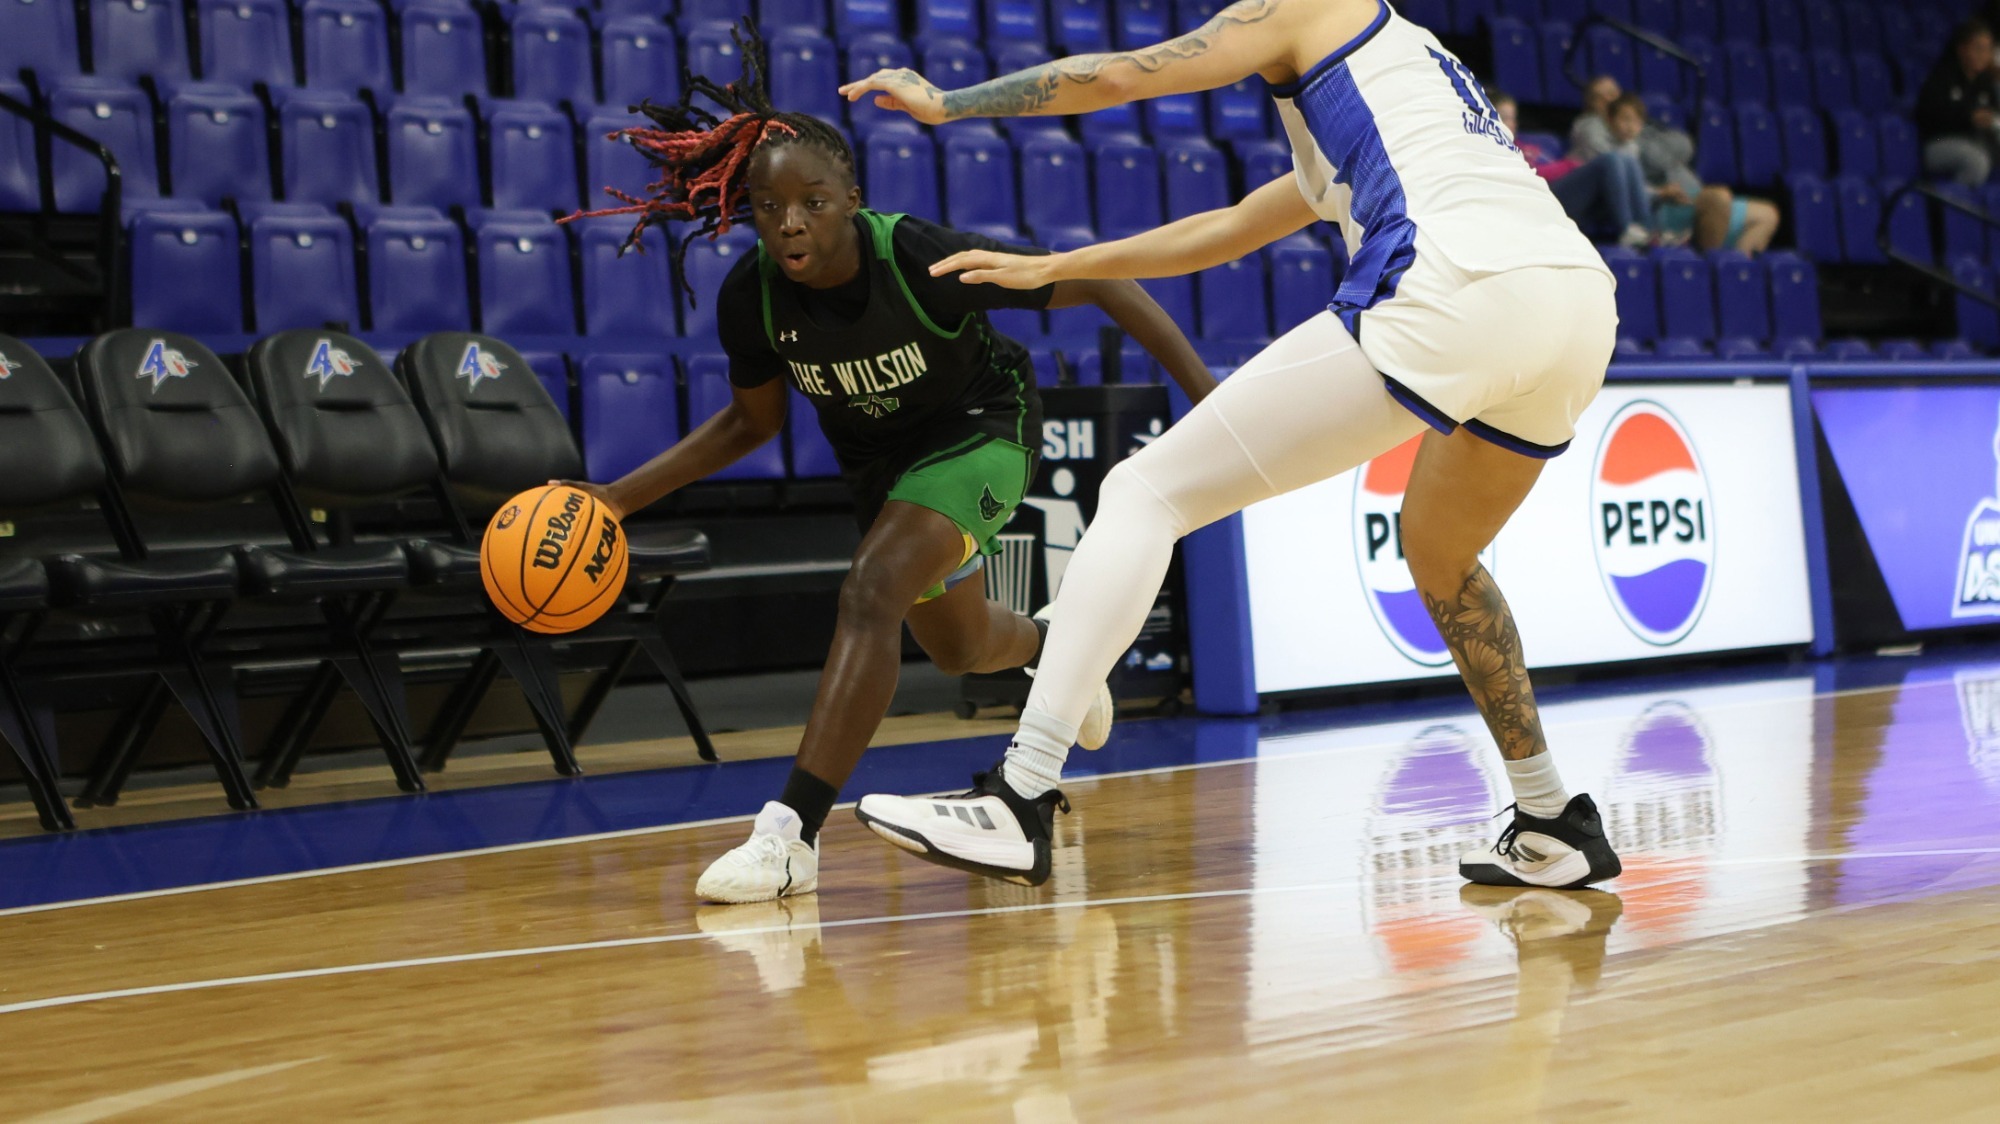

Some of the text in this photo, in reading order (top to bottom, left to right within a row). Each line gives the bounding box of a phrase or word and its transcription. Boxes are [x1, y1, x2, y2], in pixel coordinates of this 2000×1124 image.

[788, 342, 927, 395] THE WILSON
[1042, 419, 1094, 460] SH
[532, 492, 585, 570] Wilson
[584, 513, 618, 583] NCAA
[1601, 498, 1706, 547] PEPSI
